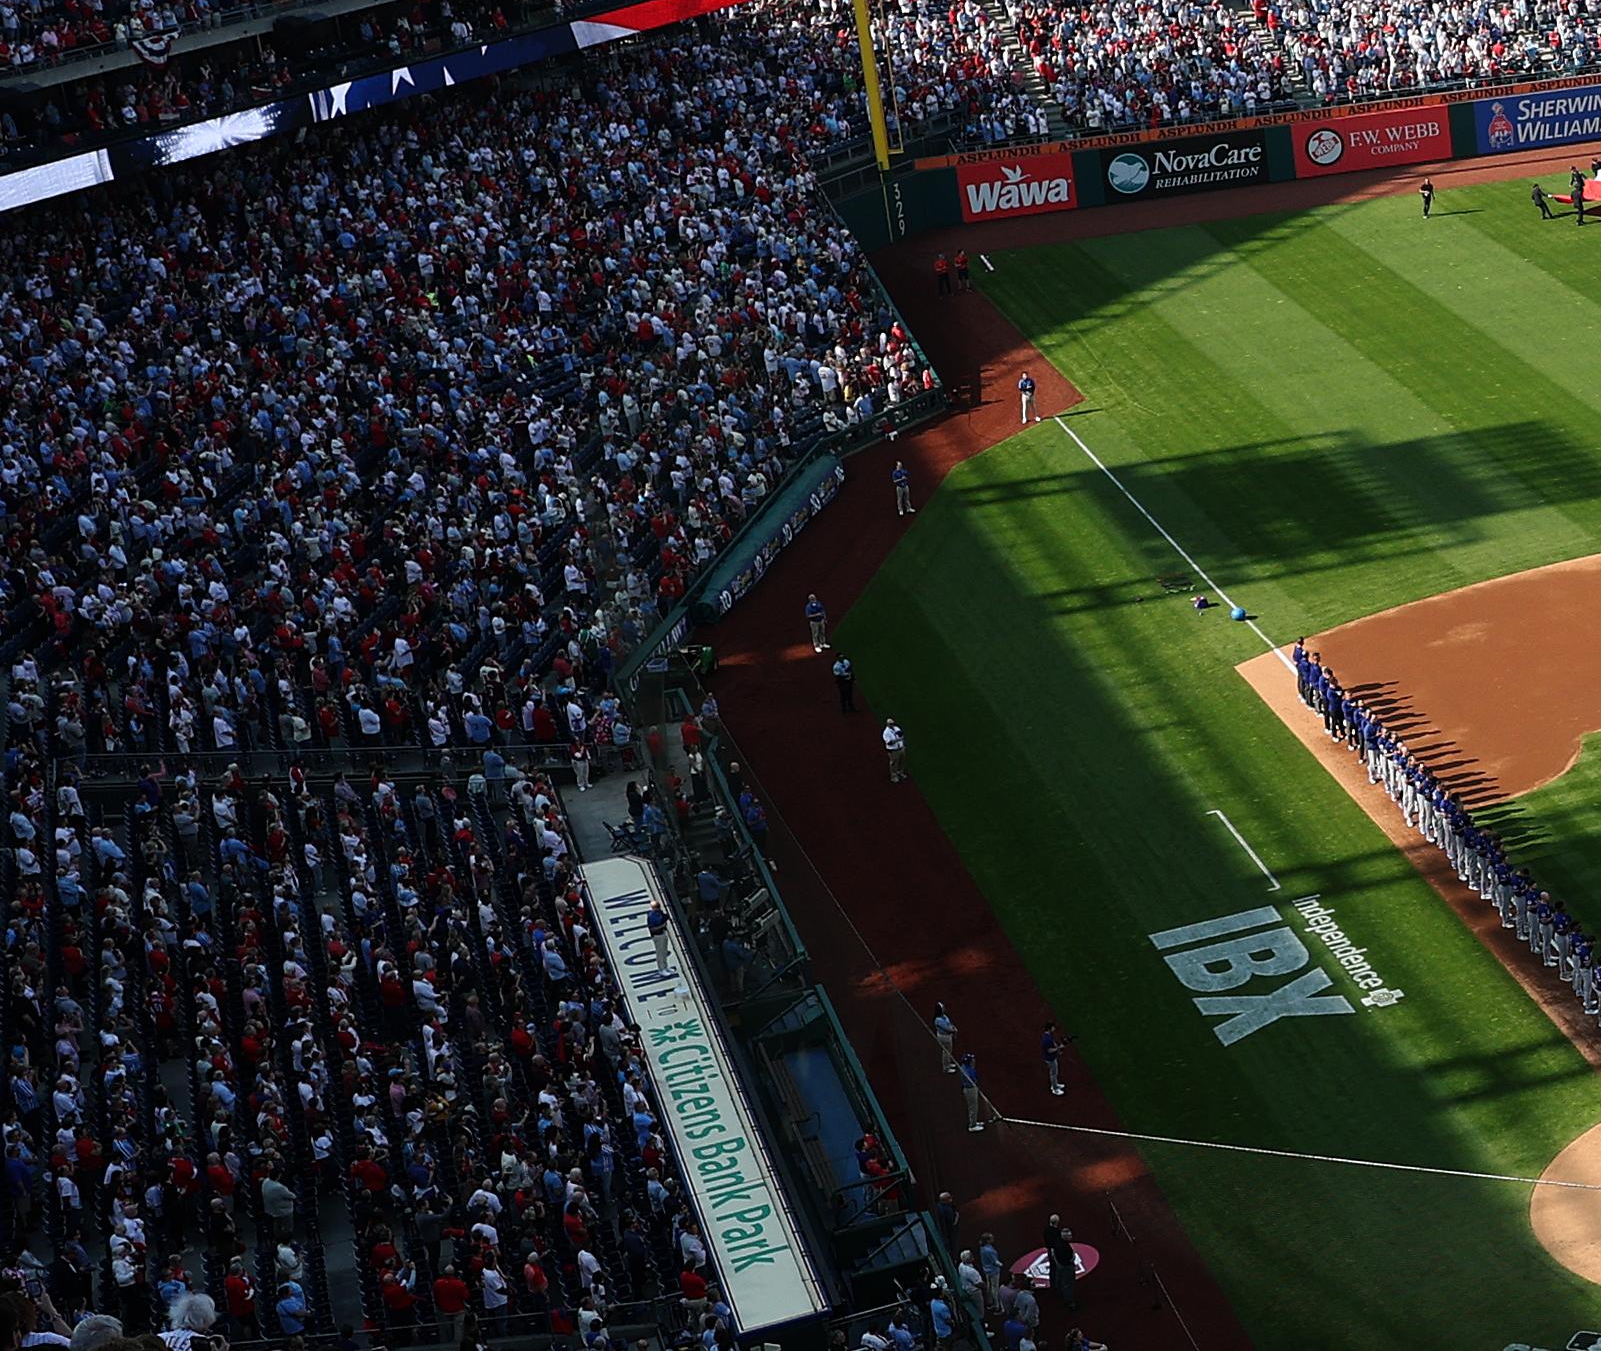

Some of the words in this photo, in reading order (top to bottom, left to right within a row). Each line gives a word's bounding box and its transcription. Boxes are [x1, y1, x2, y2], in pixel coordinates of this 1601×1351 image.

[1439, 86, 1514, 104] ASPLUNDH
[1528, 75, 1601, 93] ASPLUNDH
[1253, 108, 1332, 128] ASPLUNDH
[1347, 97, 1425, 115] ASPLUNDH
[1058, 132, 1141, 152] ASPLUNDH
[1156, 120, 1237, 139] ASPLUNDH
[1349, 129, 1383, 147] F.W.
[1385, 120, 1441, 141] WEBB
[956, 146, 1041, 166] ASPLUNDH
[1152, 143, 1262, 174] NovaCare
[1370, 142, 1420, 156] COMPANY
[1155, 165, 1260, 190] REHABILITATION
[965, 177, 1071, 213] Wawa
[893, 182, 906, 237] 329
[1292, 893, 1384, 991] Independence
[1148, 905, 1357, 1048] IBX
[657, 1043, 726, 1140] Citizens
[694, 1135, 753, 1218] Bank
[715, 1202, 789, 1275] Park
